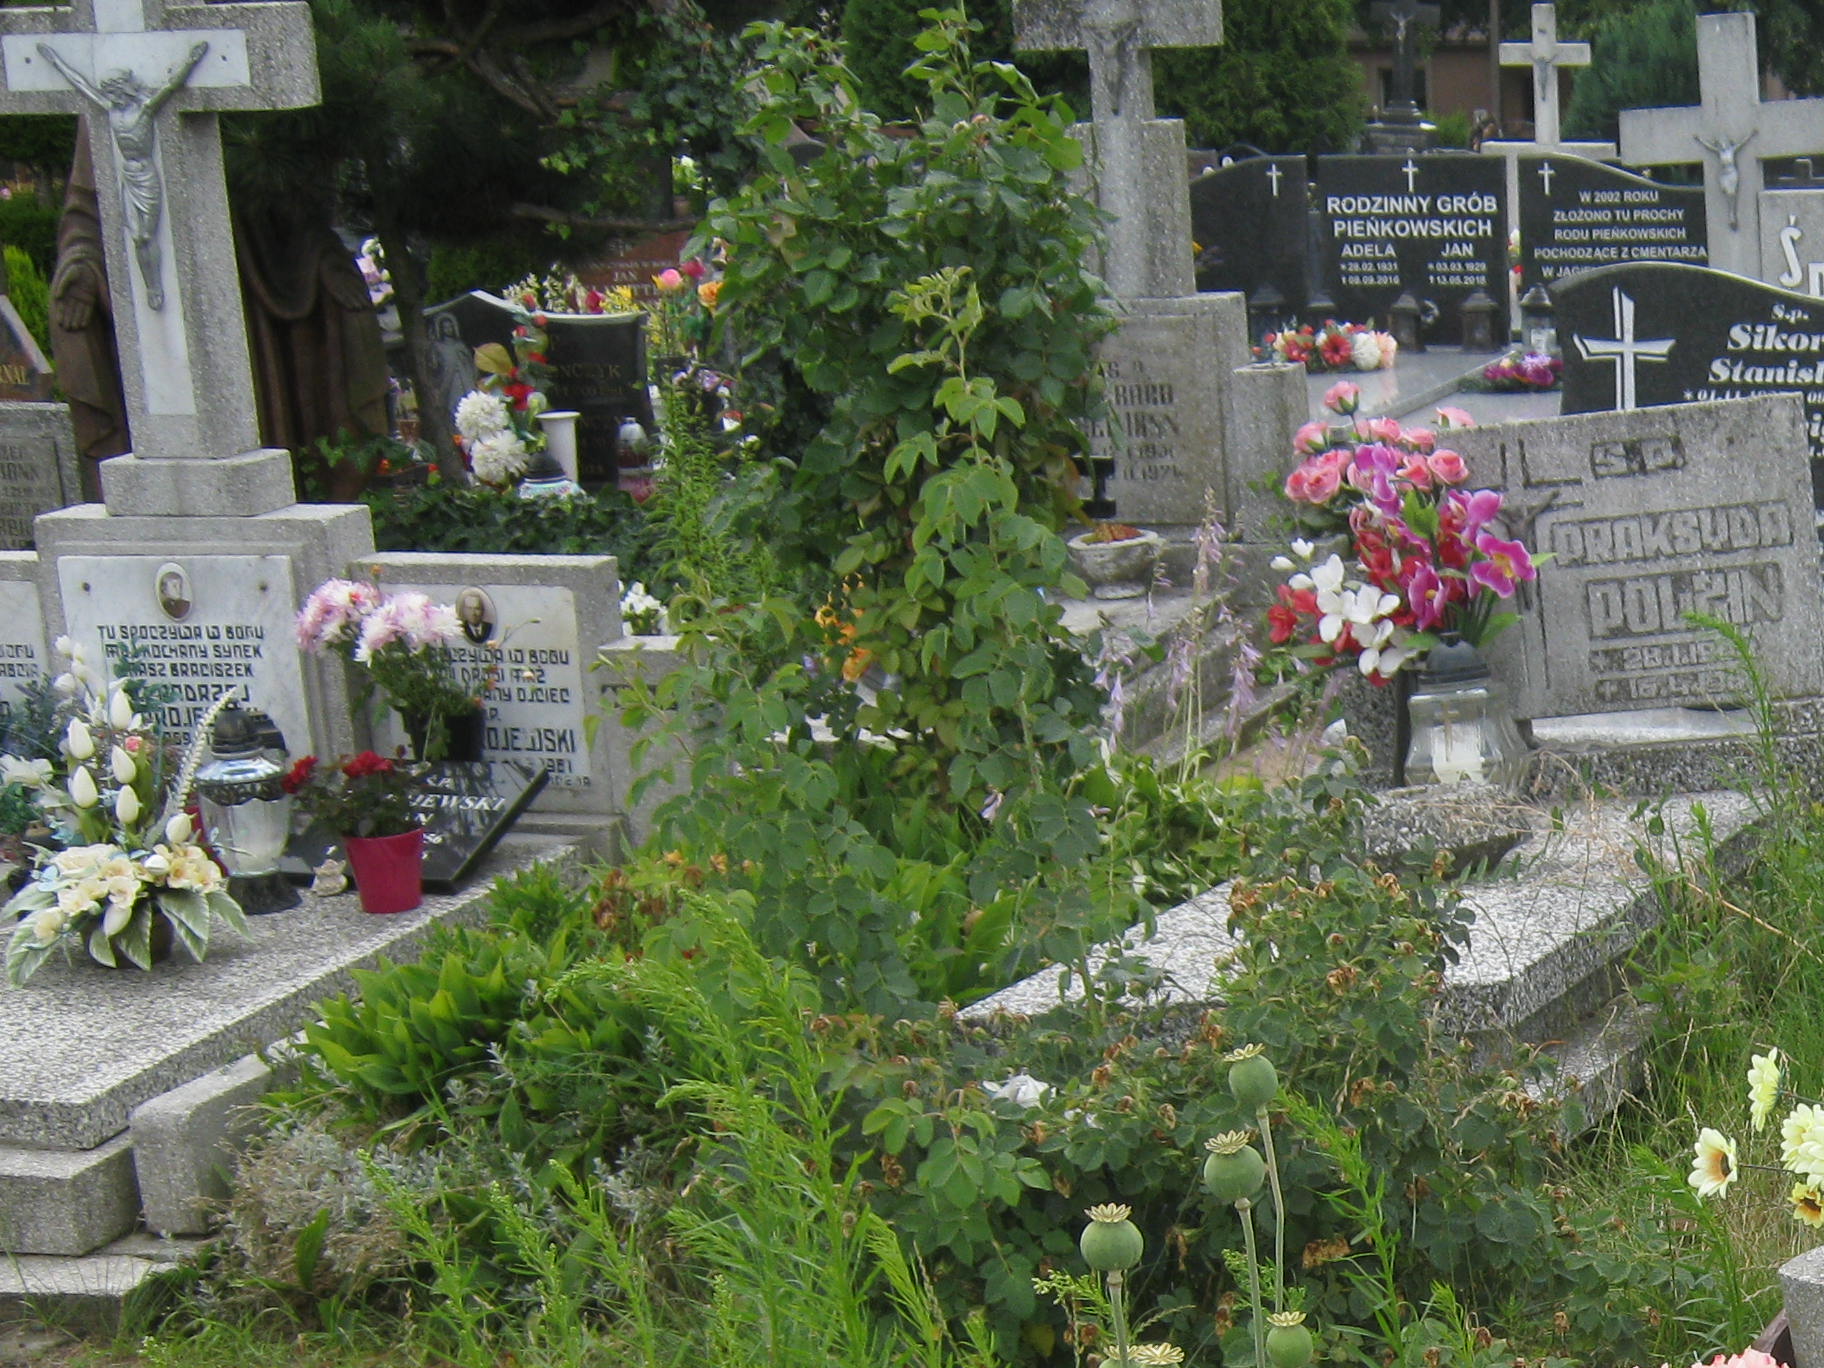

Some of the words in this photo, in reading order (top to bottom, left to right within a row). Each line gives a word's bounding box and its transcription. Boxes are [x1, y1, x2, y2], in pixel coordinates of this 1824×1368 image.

[1326, 195, 1431, 214] RODZINNY
[1436, 191, 1498, 214] GRÓB
[1579, 191, 1593, 203] W
[1594, 190, 1620, 203] 2002
[1623, 190, 1659, 203] ROKU
[1552, 208, 1612, 222] ZŁOŻONO
[1614, 209, 1630, 221] TU
[1633, 208, 1685, 222] PROCHY
[1333, 215, 1493, 238] PIEŃKOWSKICH
[1554, 228, 1589, 241] RODU
[1592, 225, 1687, 240] PIEŃKOWSKICH
[1341, 242, 1397, 257] ADELA
[1440, 242, 1474, 257] JAN
[1534, 246, 1618, 261] POCHODZĄCE
[1621, 246, 1629, 257] Z
[1631, 246, 1708, 258] CMENTARZA
[1541, 265, 1554, 279] W
[97, 625, 116, 640] TU
[120, 625, 203, 640] SPOCZYWA
[206, 625, 221, 640] W
[213, 643, 263, 659] SYNEK
[170, 662, 255, 678] BRACISZEK
